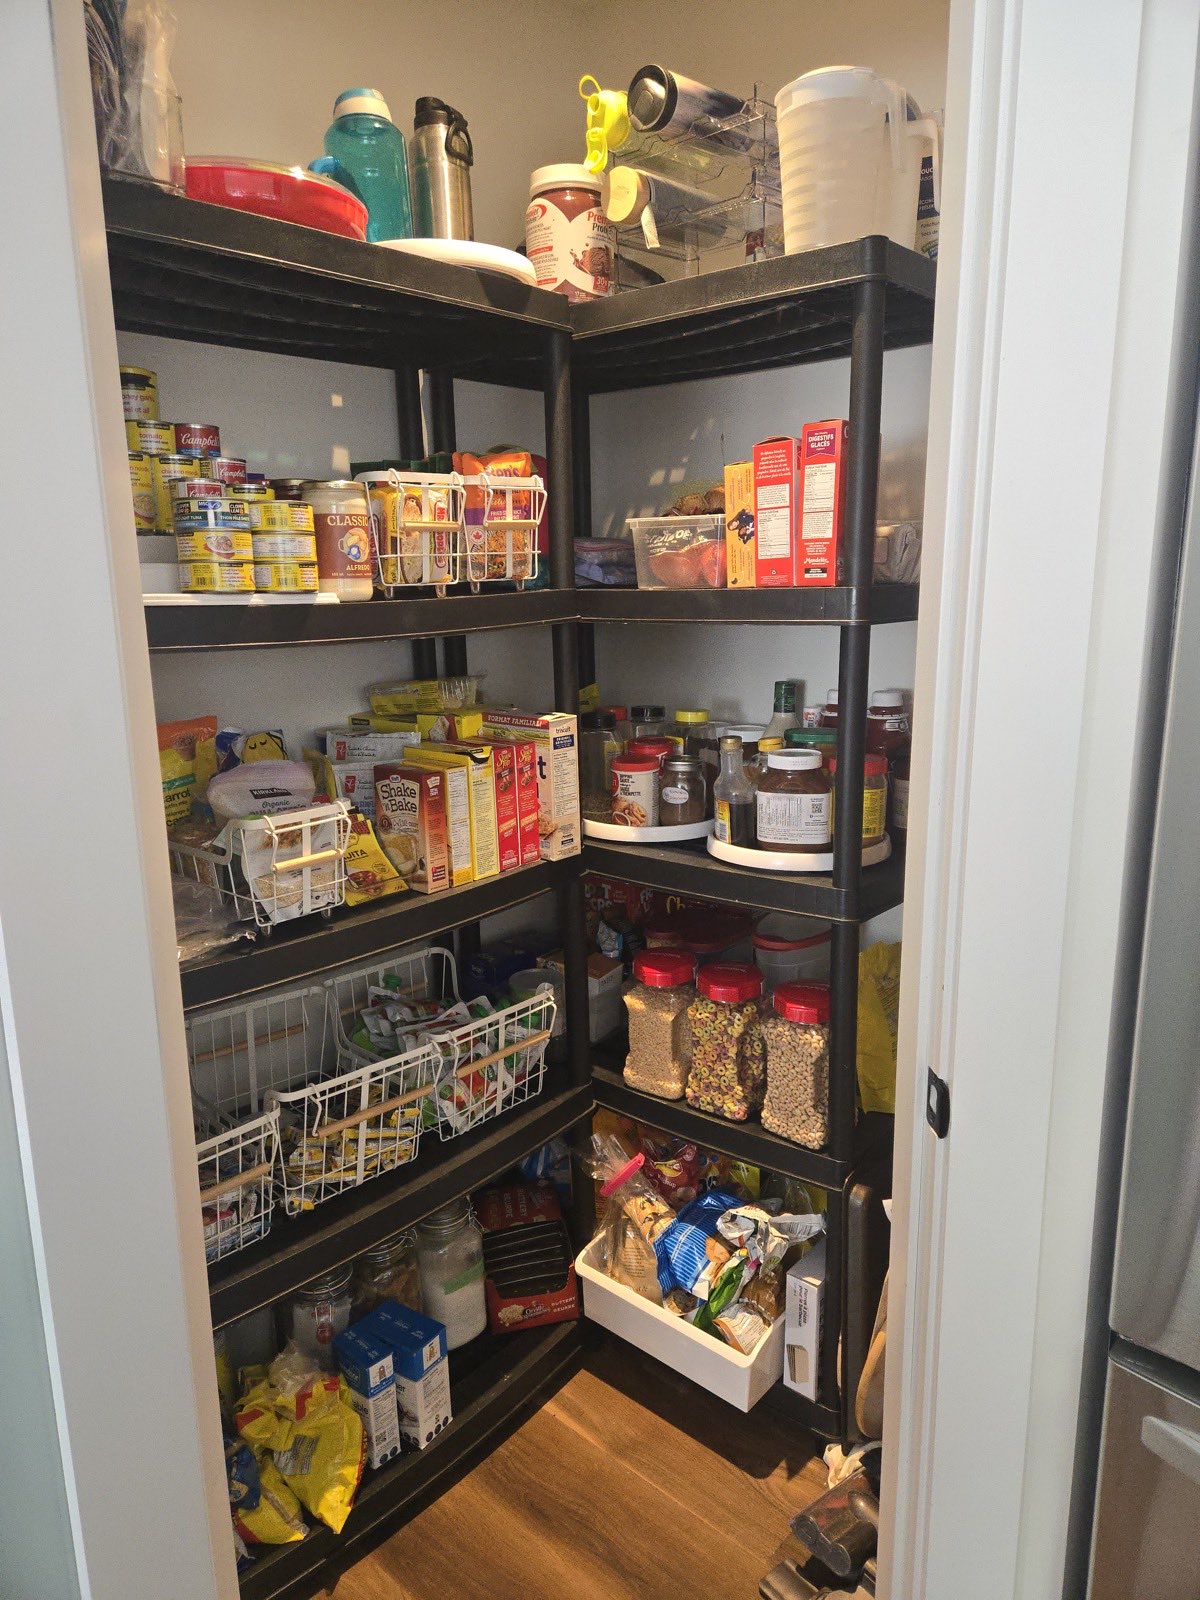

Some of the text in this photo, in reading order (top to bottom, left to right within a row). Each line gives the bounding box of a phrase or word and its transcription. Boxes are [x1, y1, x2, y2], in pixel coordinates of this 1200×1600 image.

[808, 434, 834, 442] DIGESTIFS
[810, 440, 831, 449] GLACÉS
[487, 714, 511, 724] FORMAT
[380, 782, 418, 800] Shake
[261, 800, 291, 809] Organic
[389, 797, 418, 814] Bake
[344, 848, 368, 861] JITA
